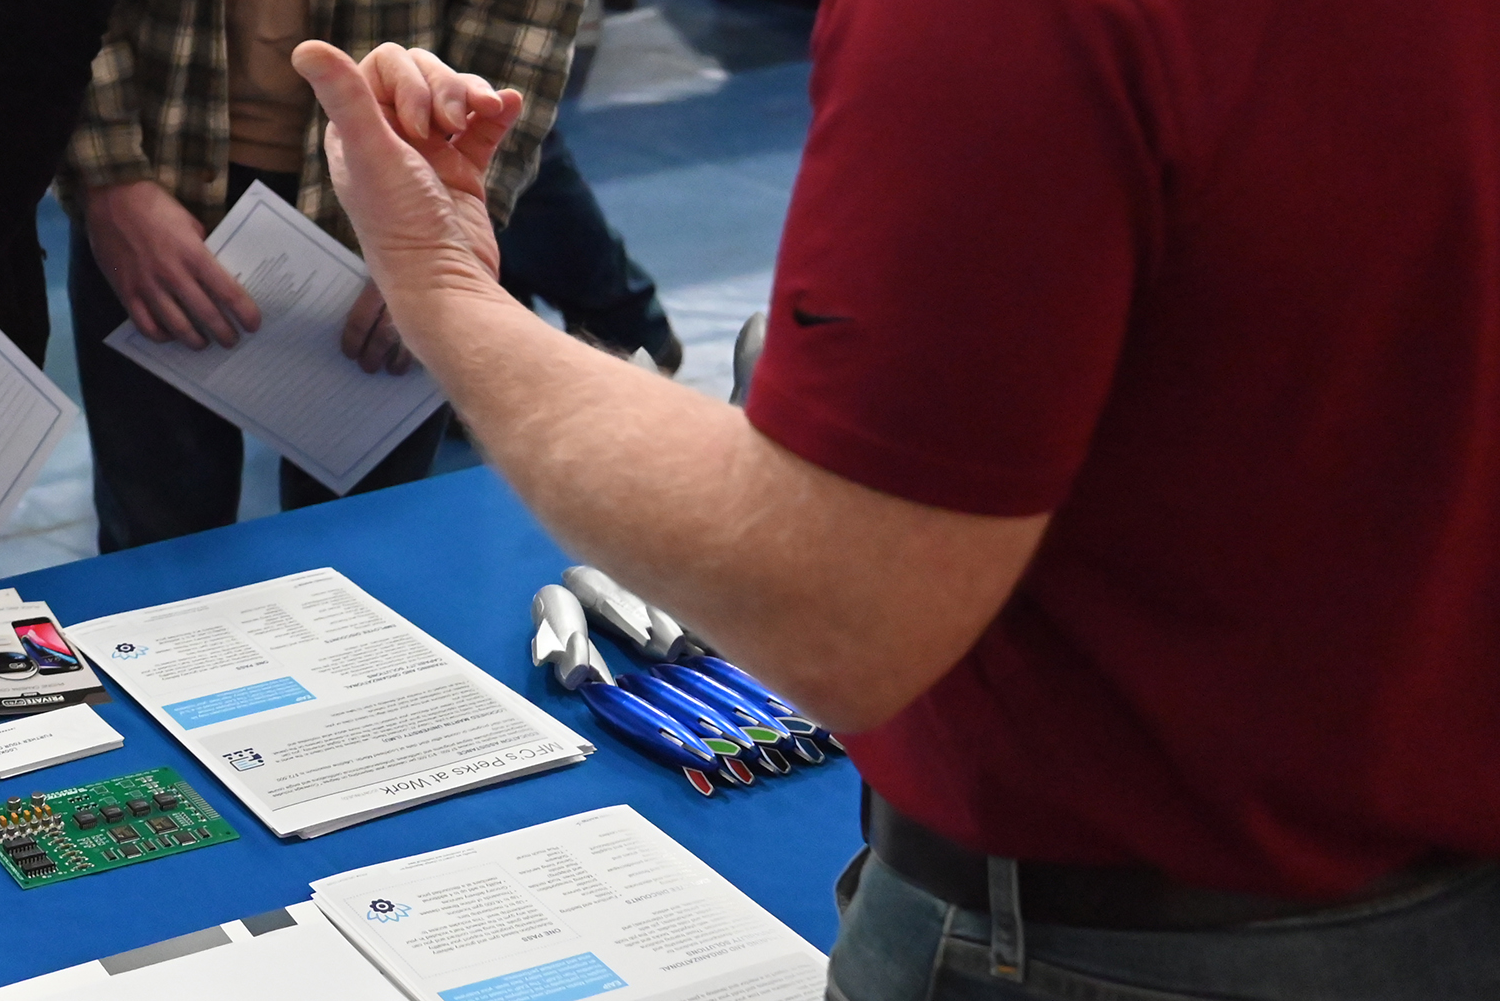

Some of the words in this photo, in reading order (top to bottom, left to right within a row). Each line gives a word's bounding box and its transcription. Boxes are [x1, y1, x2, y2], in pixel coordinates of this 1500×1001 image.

[24, 693, 64, 705] PRIVATE
[22, 732, 52, 743] FURTHER
[4, 740, 21, 748] YOUR
[502, 740, 565, 763] MFC's
[448, 756, 506, 777] Perks
[427, 770, 452, 783] at
[377, 776, 432, 797] Work
[519, 932, 544, 942] PASS
[541, 927, 562, 936] ONE
